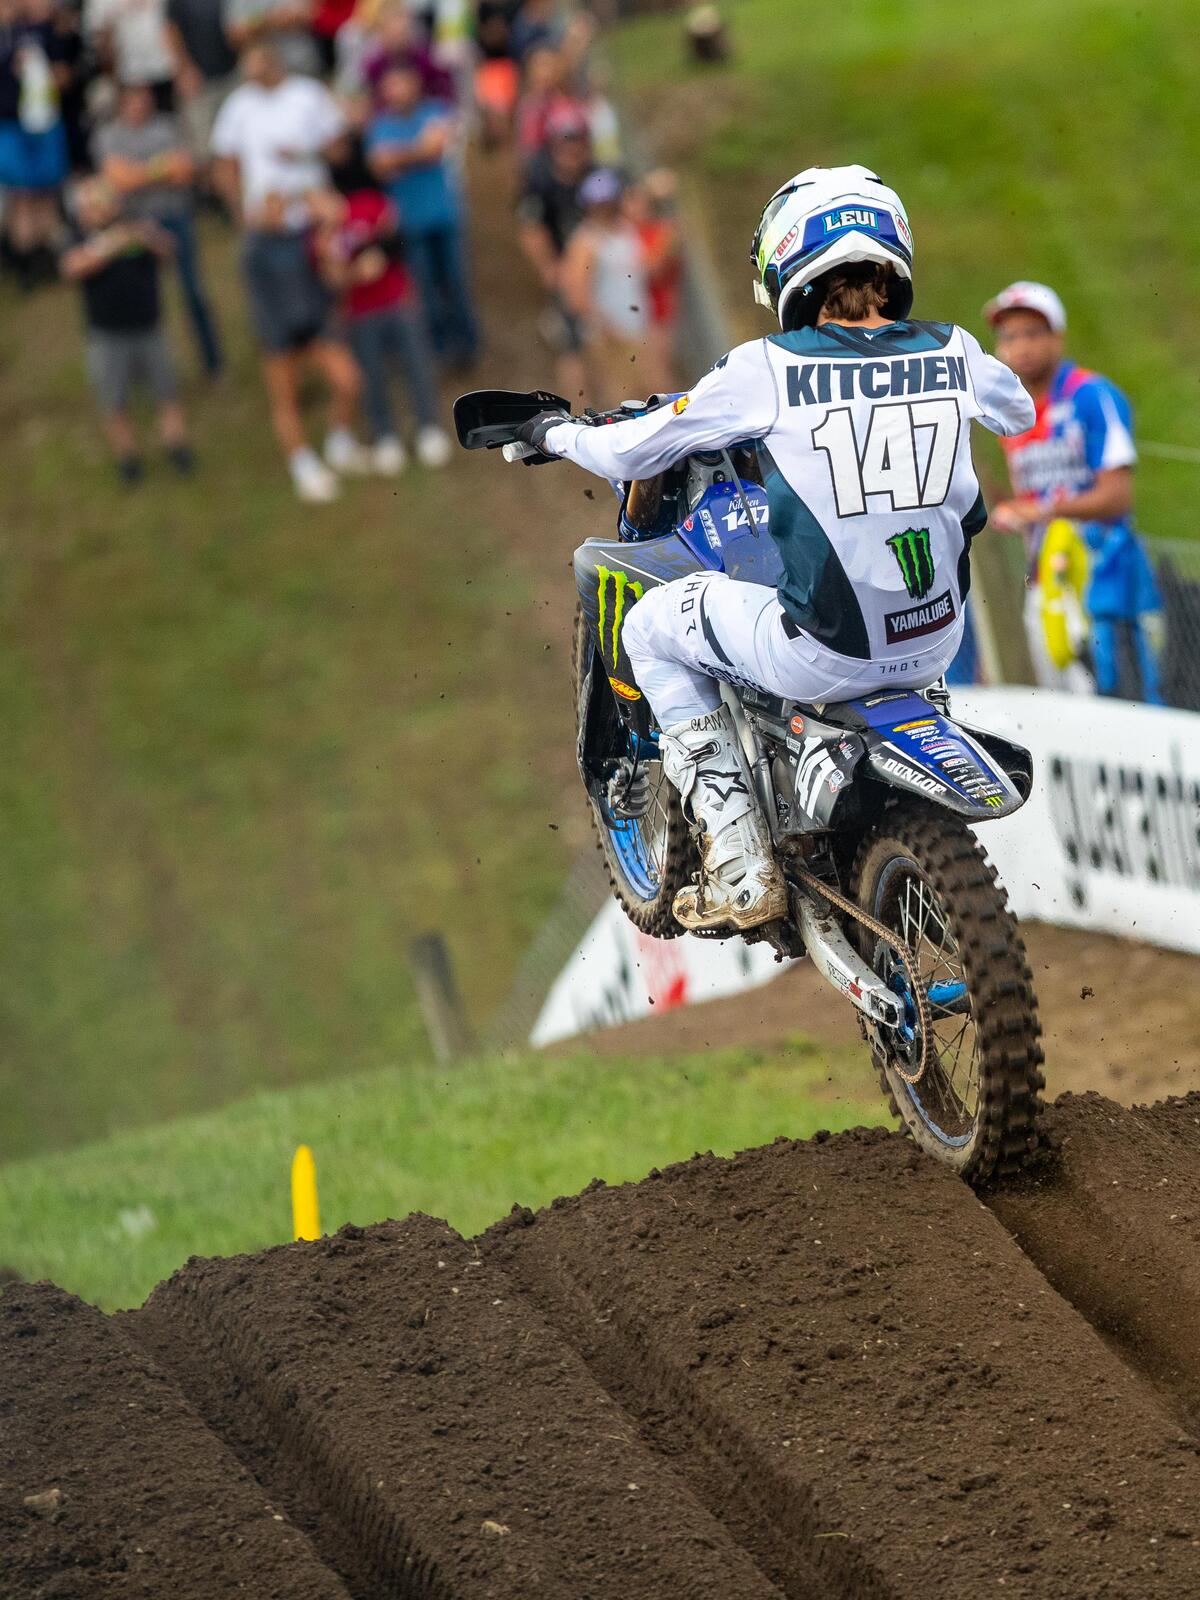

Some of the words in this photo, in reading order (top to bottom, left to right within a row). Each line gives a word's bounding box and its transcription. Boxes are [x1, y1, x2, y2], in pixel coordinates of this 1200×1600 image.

[776, 231, 796, 257] BELL
[786, 356, 967, 407] KITCHEN
[811, 397, 961, 519] 147
[721, 505, 768, 532] 147
[890, 597, 951, 633] YAMALUBE
[882, 758, 946, 796] DUNLOP
